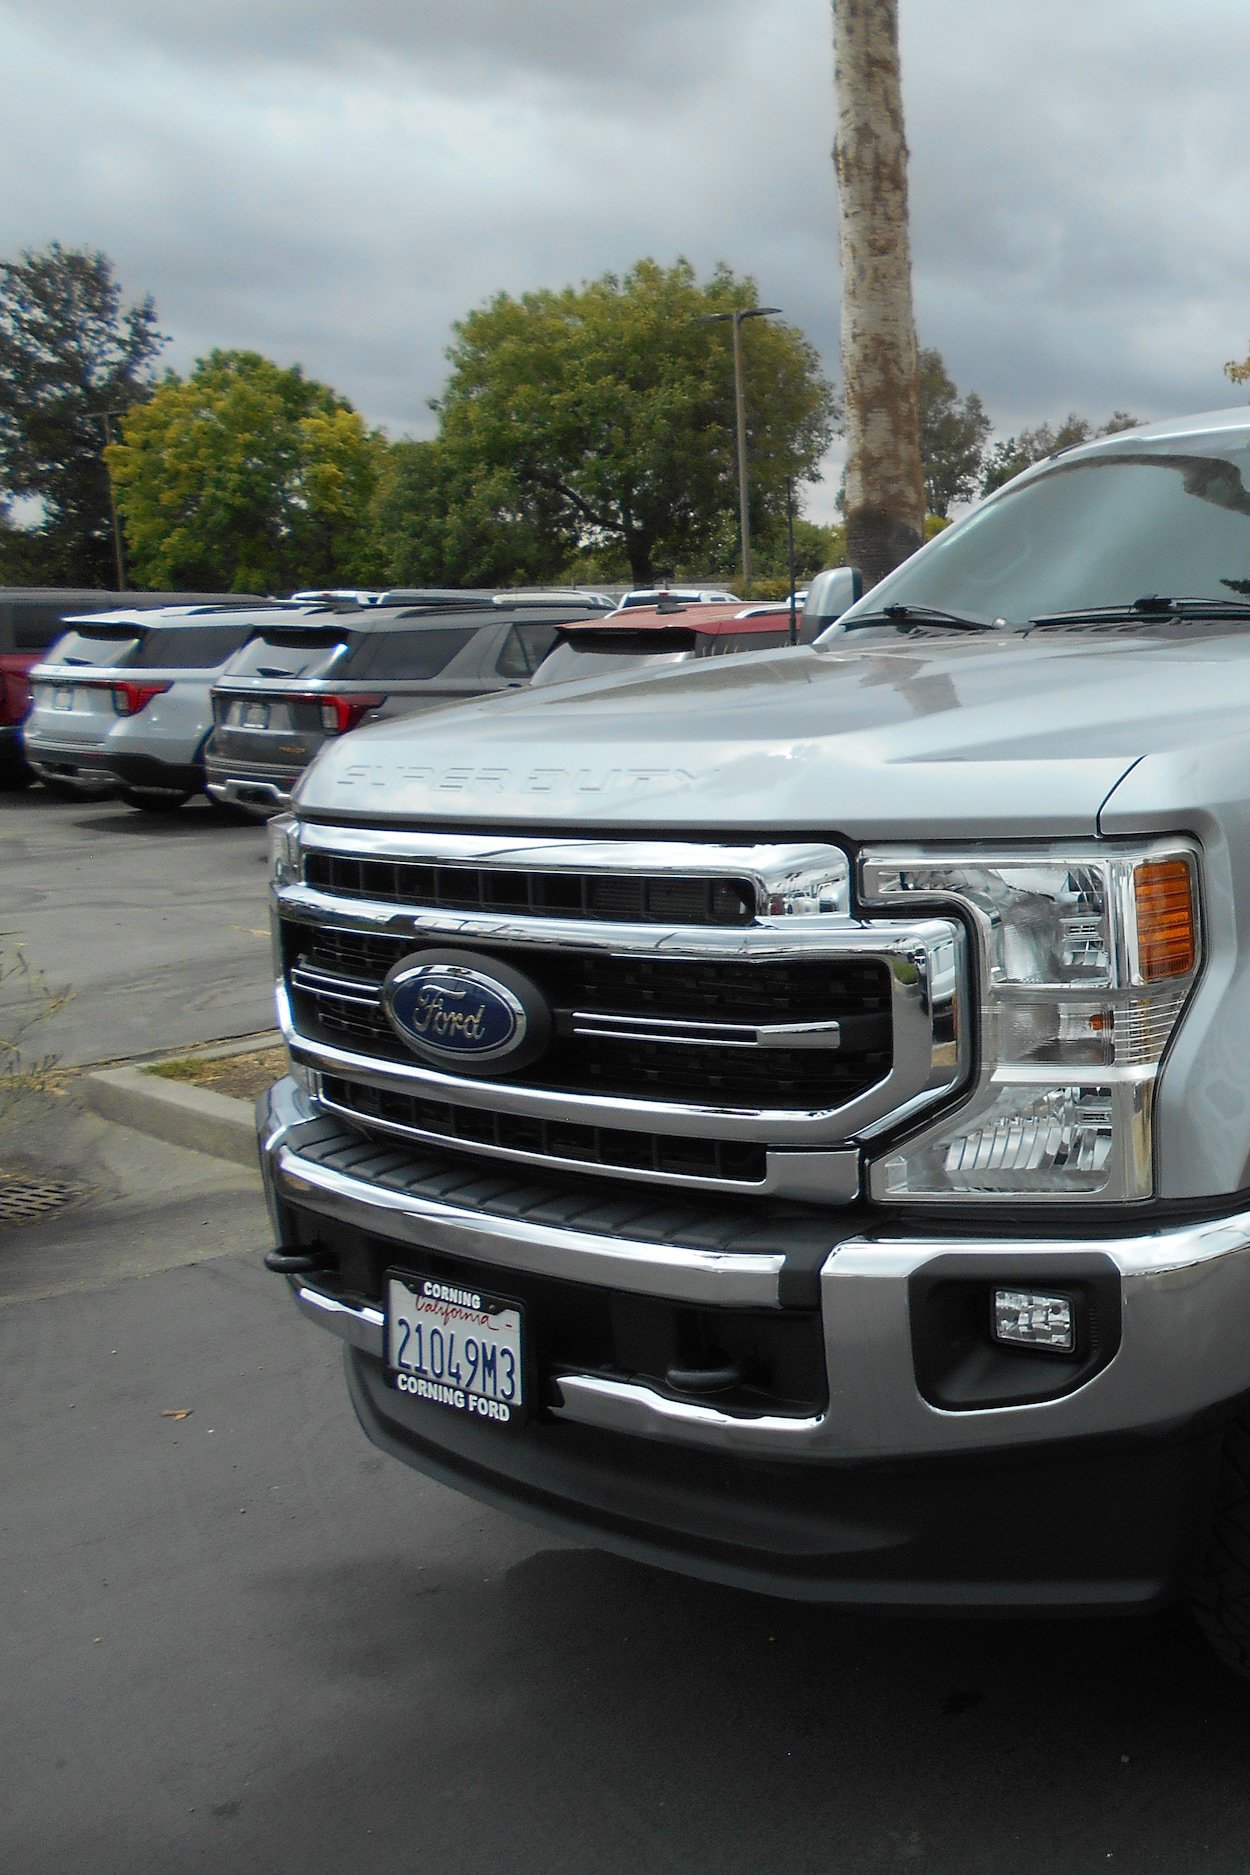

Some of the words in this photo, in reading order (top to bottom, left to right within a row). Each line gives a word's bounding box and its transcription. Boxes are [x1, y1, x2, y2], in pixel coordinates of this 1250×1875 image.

[336, 764, 512, 793] SUPER
[521, 767, 722, 794] DUTY
[412, 984, 486, 1040] Ford
[415, 1296, 499, 1331] California
[423, 1281, 481, 1309] CORNING
[398, 1317, 515, 1401] 21049M3
[397, 1374, 465, 1409] CORNING
[468, 1394, 511, 1422] FORD
